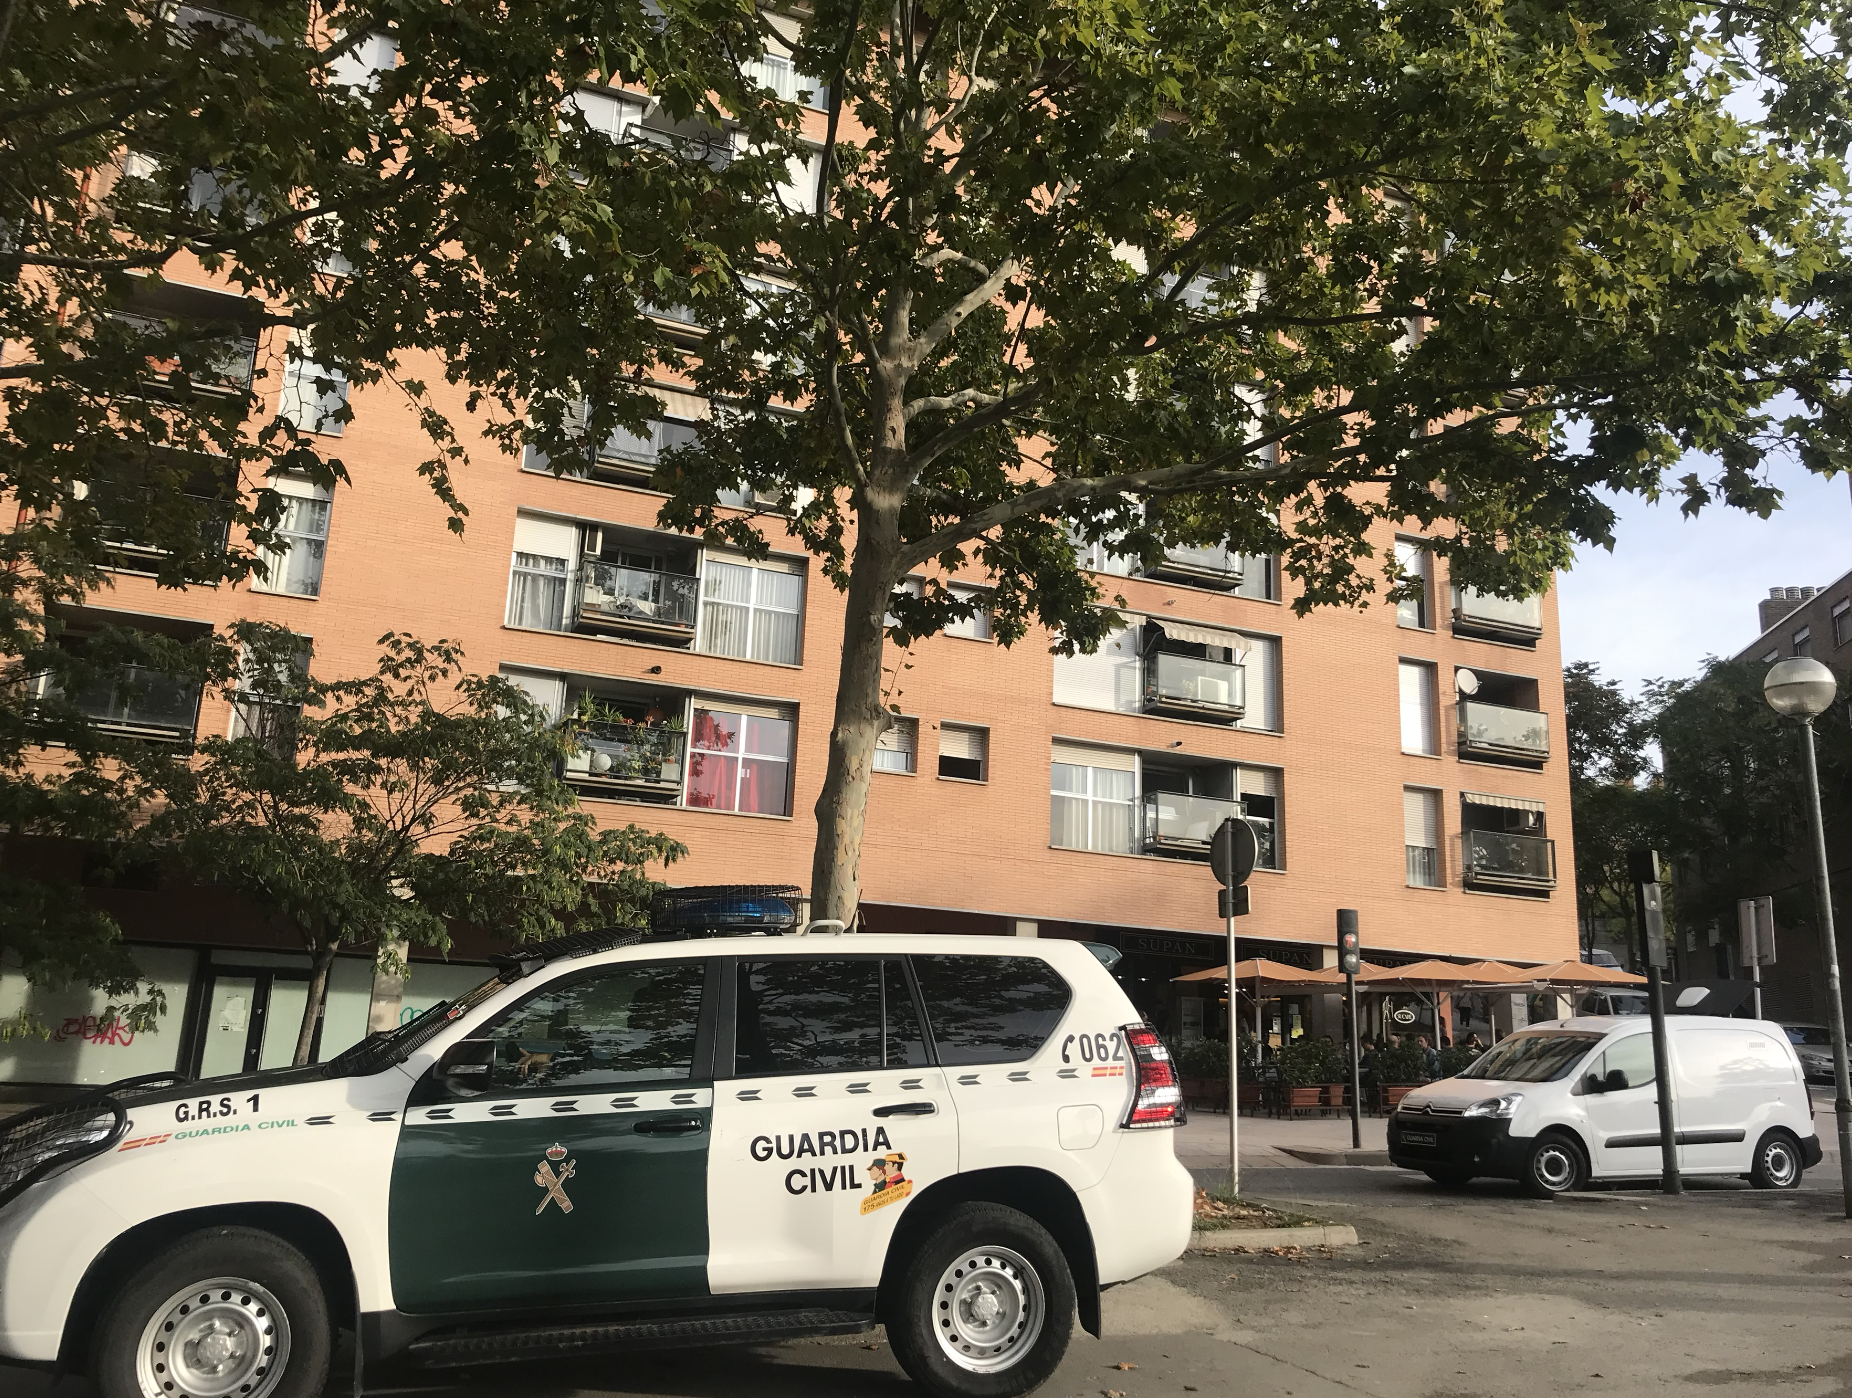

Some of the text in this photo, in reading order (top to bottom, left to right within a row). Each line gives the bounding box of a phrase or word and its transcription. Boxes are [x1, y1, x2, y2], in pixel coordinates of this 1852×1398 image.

[1138, 939, 1196, 954] SUPAN
[1259, 949, 1312, 964] SUPAN
[1079, 1032, 1125, 1063] 062
[174, 1093, 260, 1123] G.R.S. 1
[174, 1118, 298, 1140] GUARDIA CIVIL
[750, 1126, 893, 1162] GUARDIA
[785, 1164, 863, 1196] CIVIL
[863, 1190, 890, 1206] GUARDIA
[863, 1202, 875, 1213] 175
